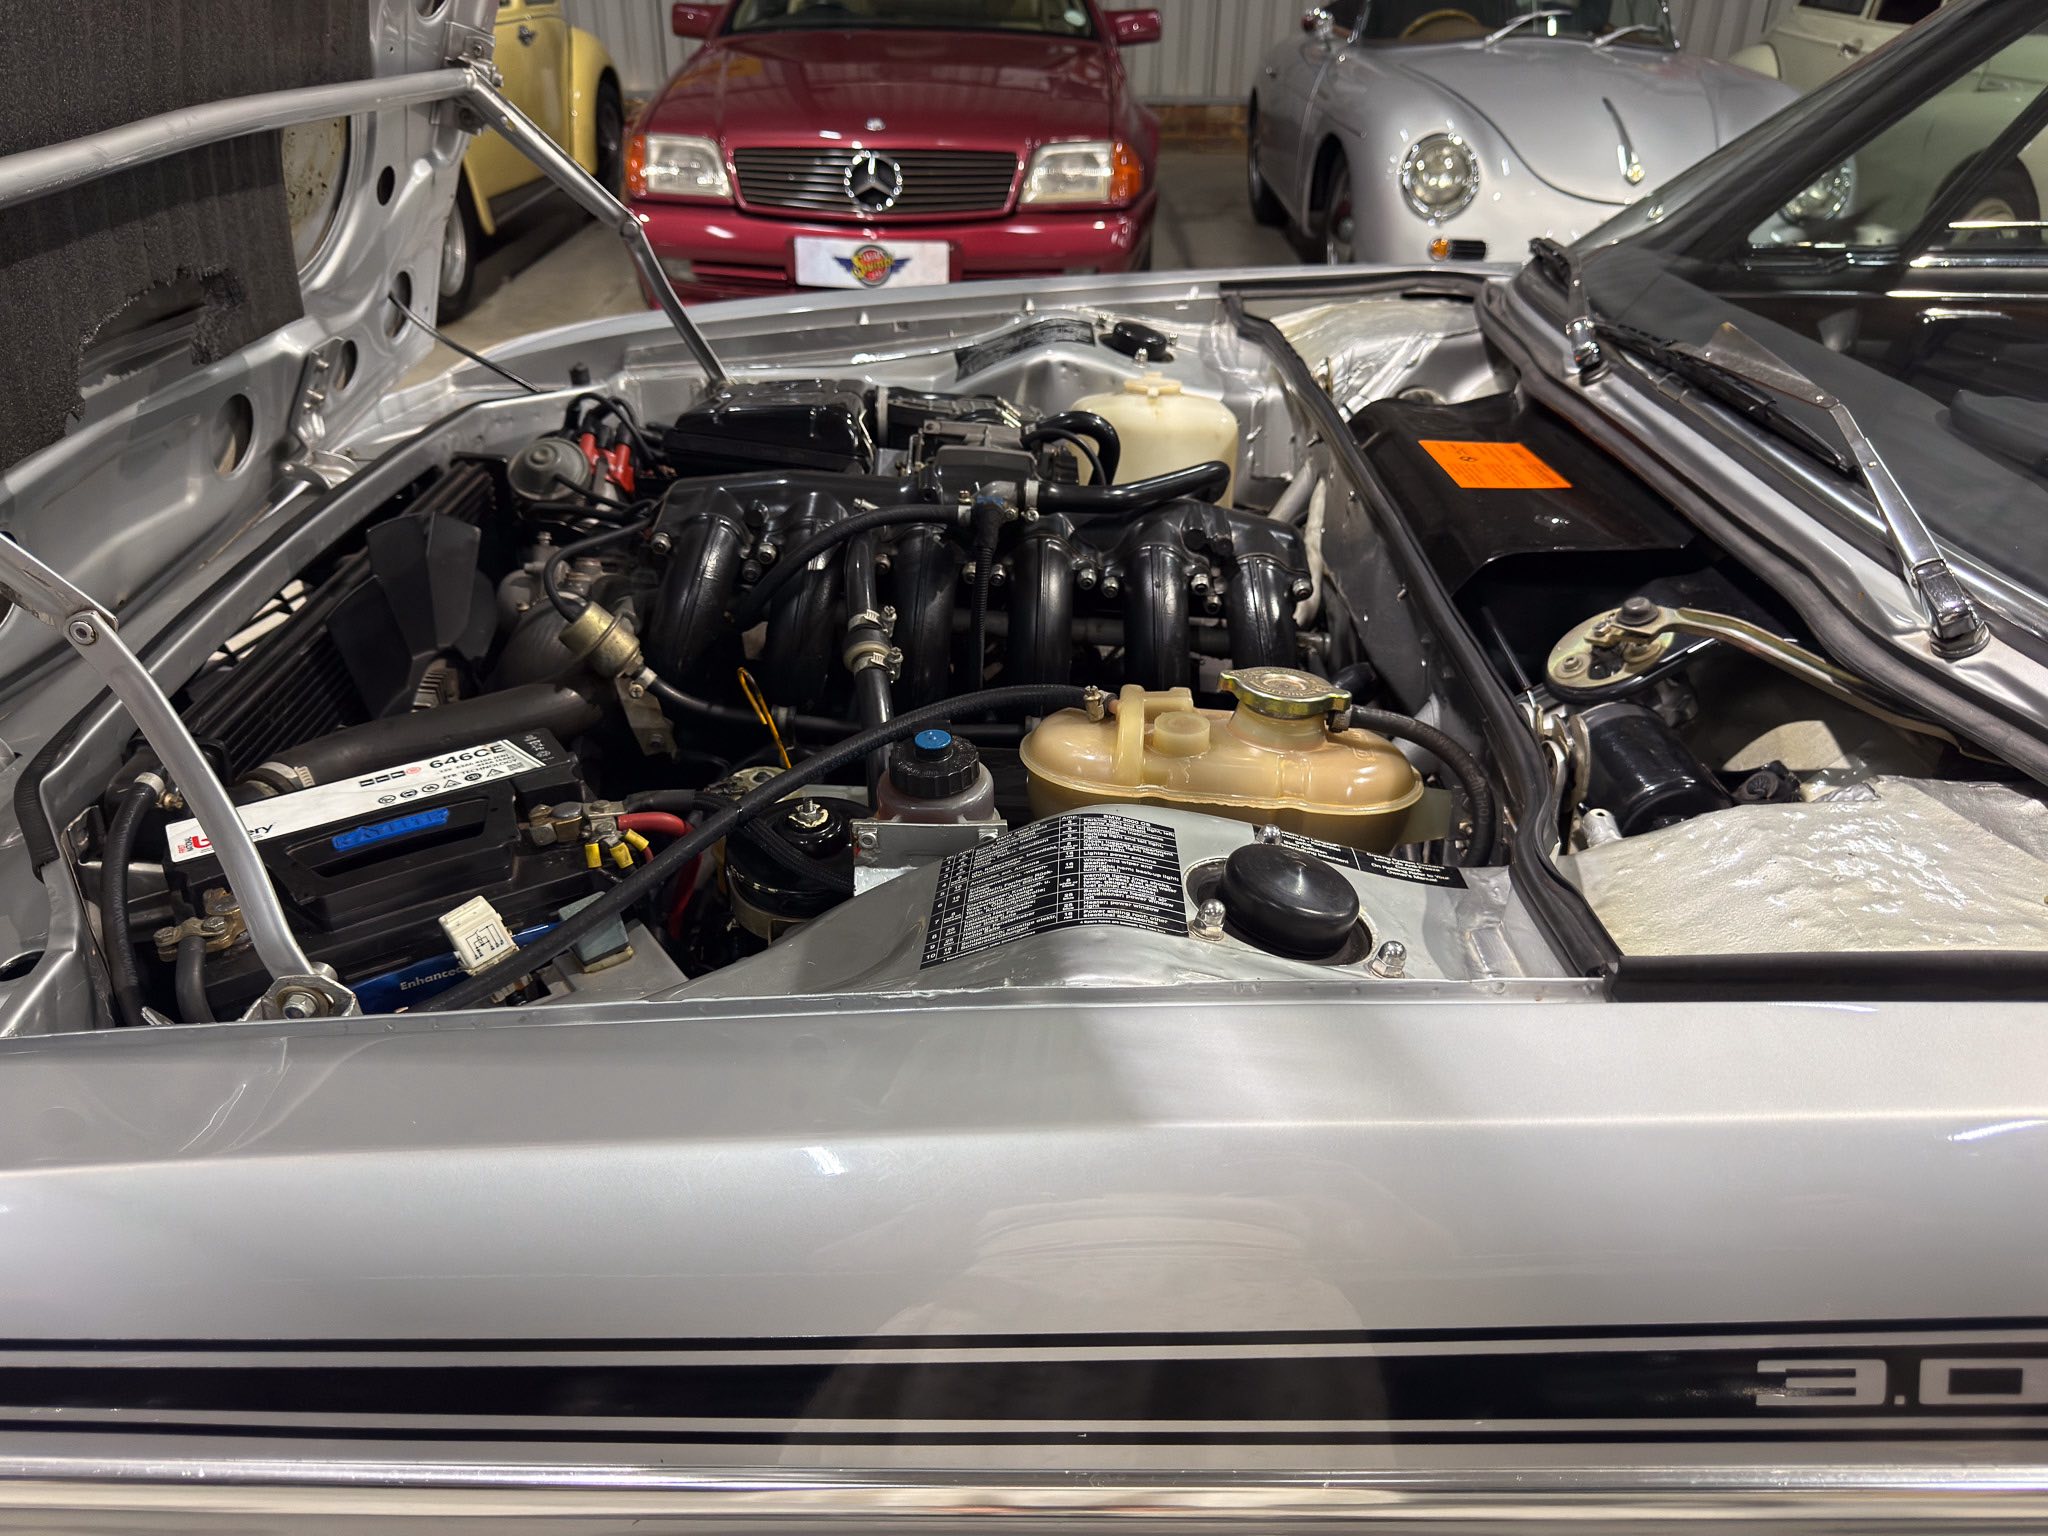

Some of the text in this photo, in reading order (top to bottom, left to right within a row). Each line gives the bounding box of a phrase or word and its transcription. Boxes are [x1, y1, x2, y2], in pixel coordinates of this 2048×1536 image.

[429, 744, 506, 769] 646CE
[1131, 856, 1157, 864] antenna
[1126, 894, 1147, 902] power
[1148, 898, 1174, 908] window
[1133, 903, 1159, 912] window
[1756, 1358, 2048, 1405] 3.0
